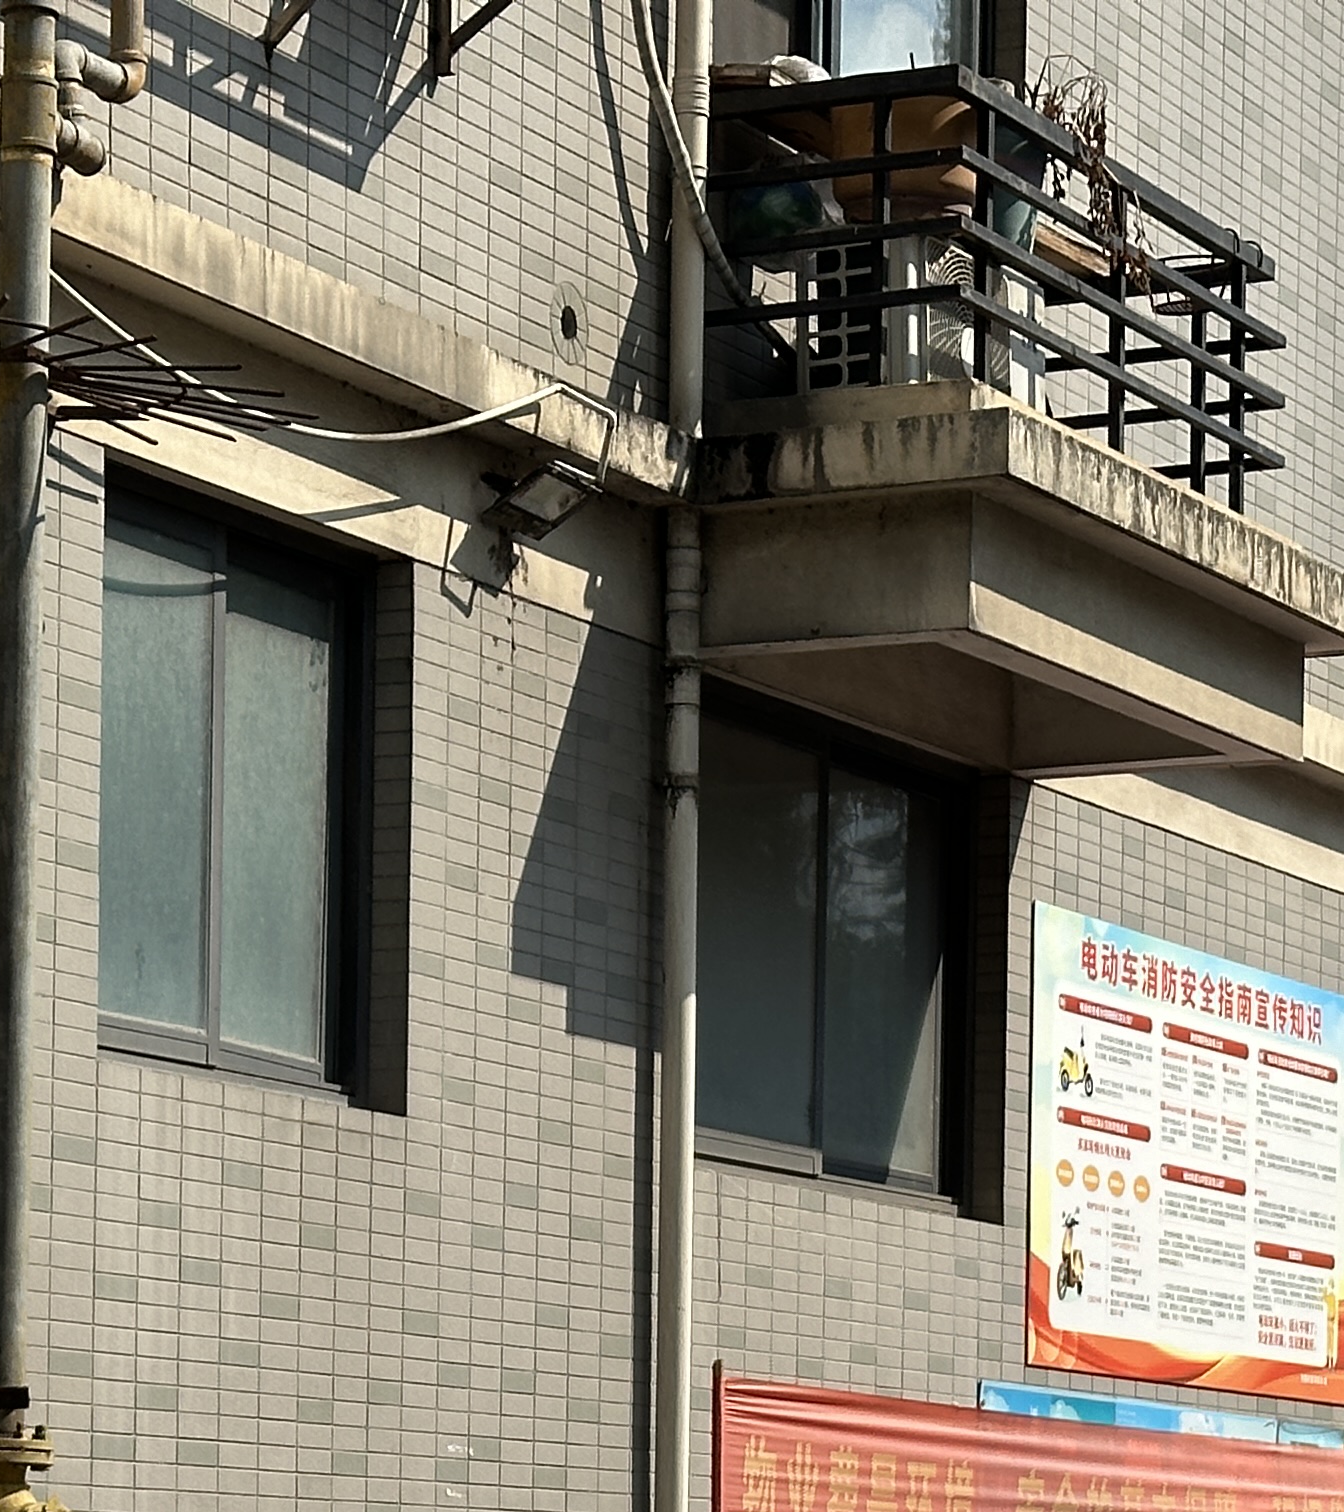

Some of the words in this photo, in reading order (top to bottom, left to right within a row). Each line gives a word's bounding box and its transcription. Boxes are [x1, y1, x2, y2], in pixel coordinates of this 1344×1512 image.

[1079, 935, 1324, 1046] 电动车消防安全指南宣传知识
